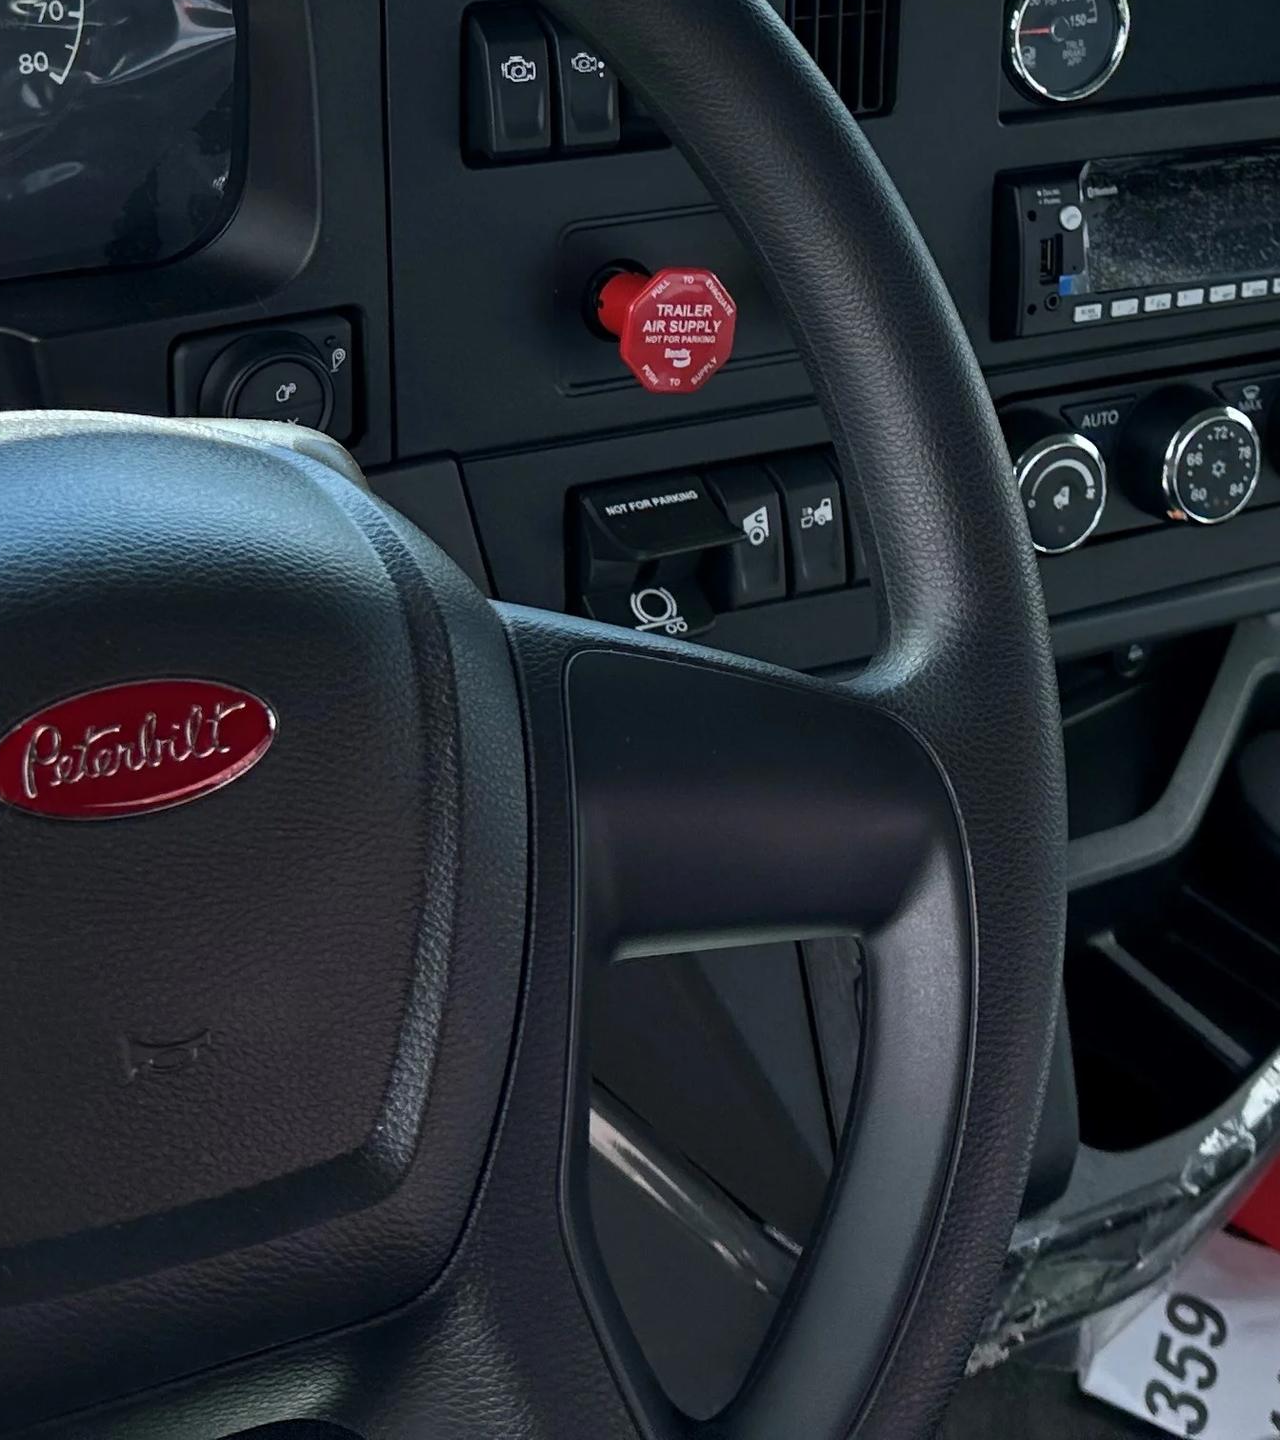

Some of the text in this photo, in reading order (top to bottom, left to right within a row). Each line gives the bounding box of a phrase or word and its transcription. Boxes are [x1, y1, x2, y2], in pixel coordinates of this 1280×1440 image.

[34, 0, 64, 23] 70
[1070, 13, 1087, 27] 150
[18, 51, 49, 74] 80
[651, 280, 671, 298] PULL
[683, 276, 694, 284] TO
[657, 304, 713, 317] TRAILER
[642, 319, 723, 333] AIR SUPPLY
[642, 356, 717, 386] PUSH TO SUPPLY
[1080, 410, 1120, 429] AUTO
[1213, 426, 1228, 439] 72
[1229, 483, 1244, 496] 84
[605, 489, 699, 517] NOT FOR PARKING
[22, 701, 246, 799] Peterbilt
[1145, 1292, 1228, 1436] 359
